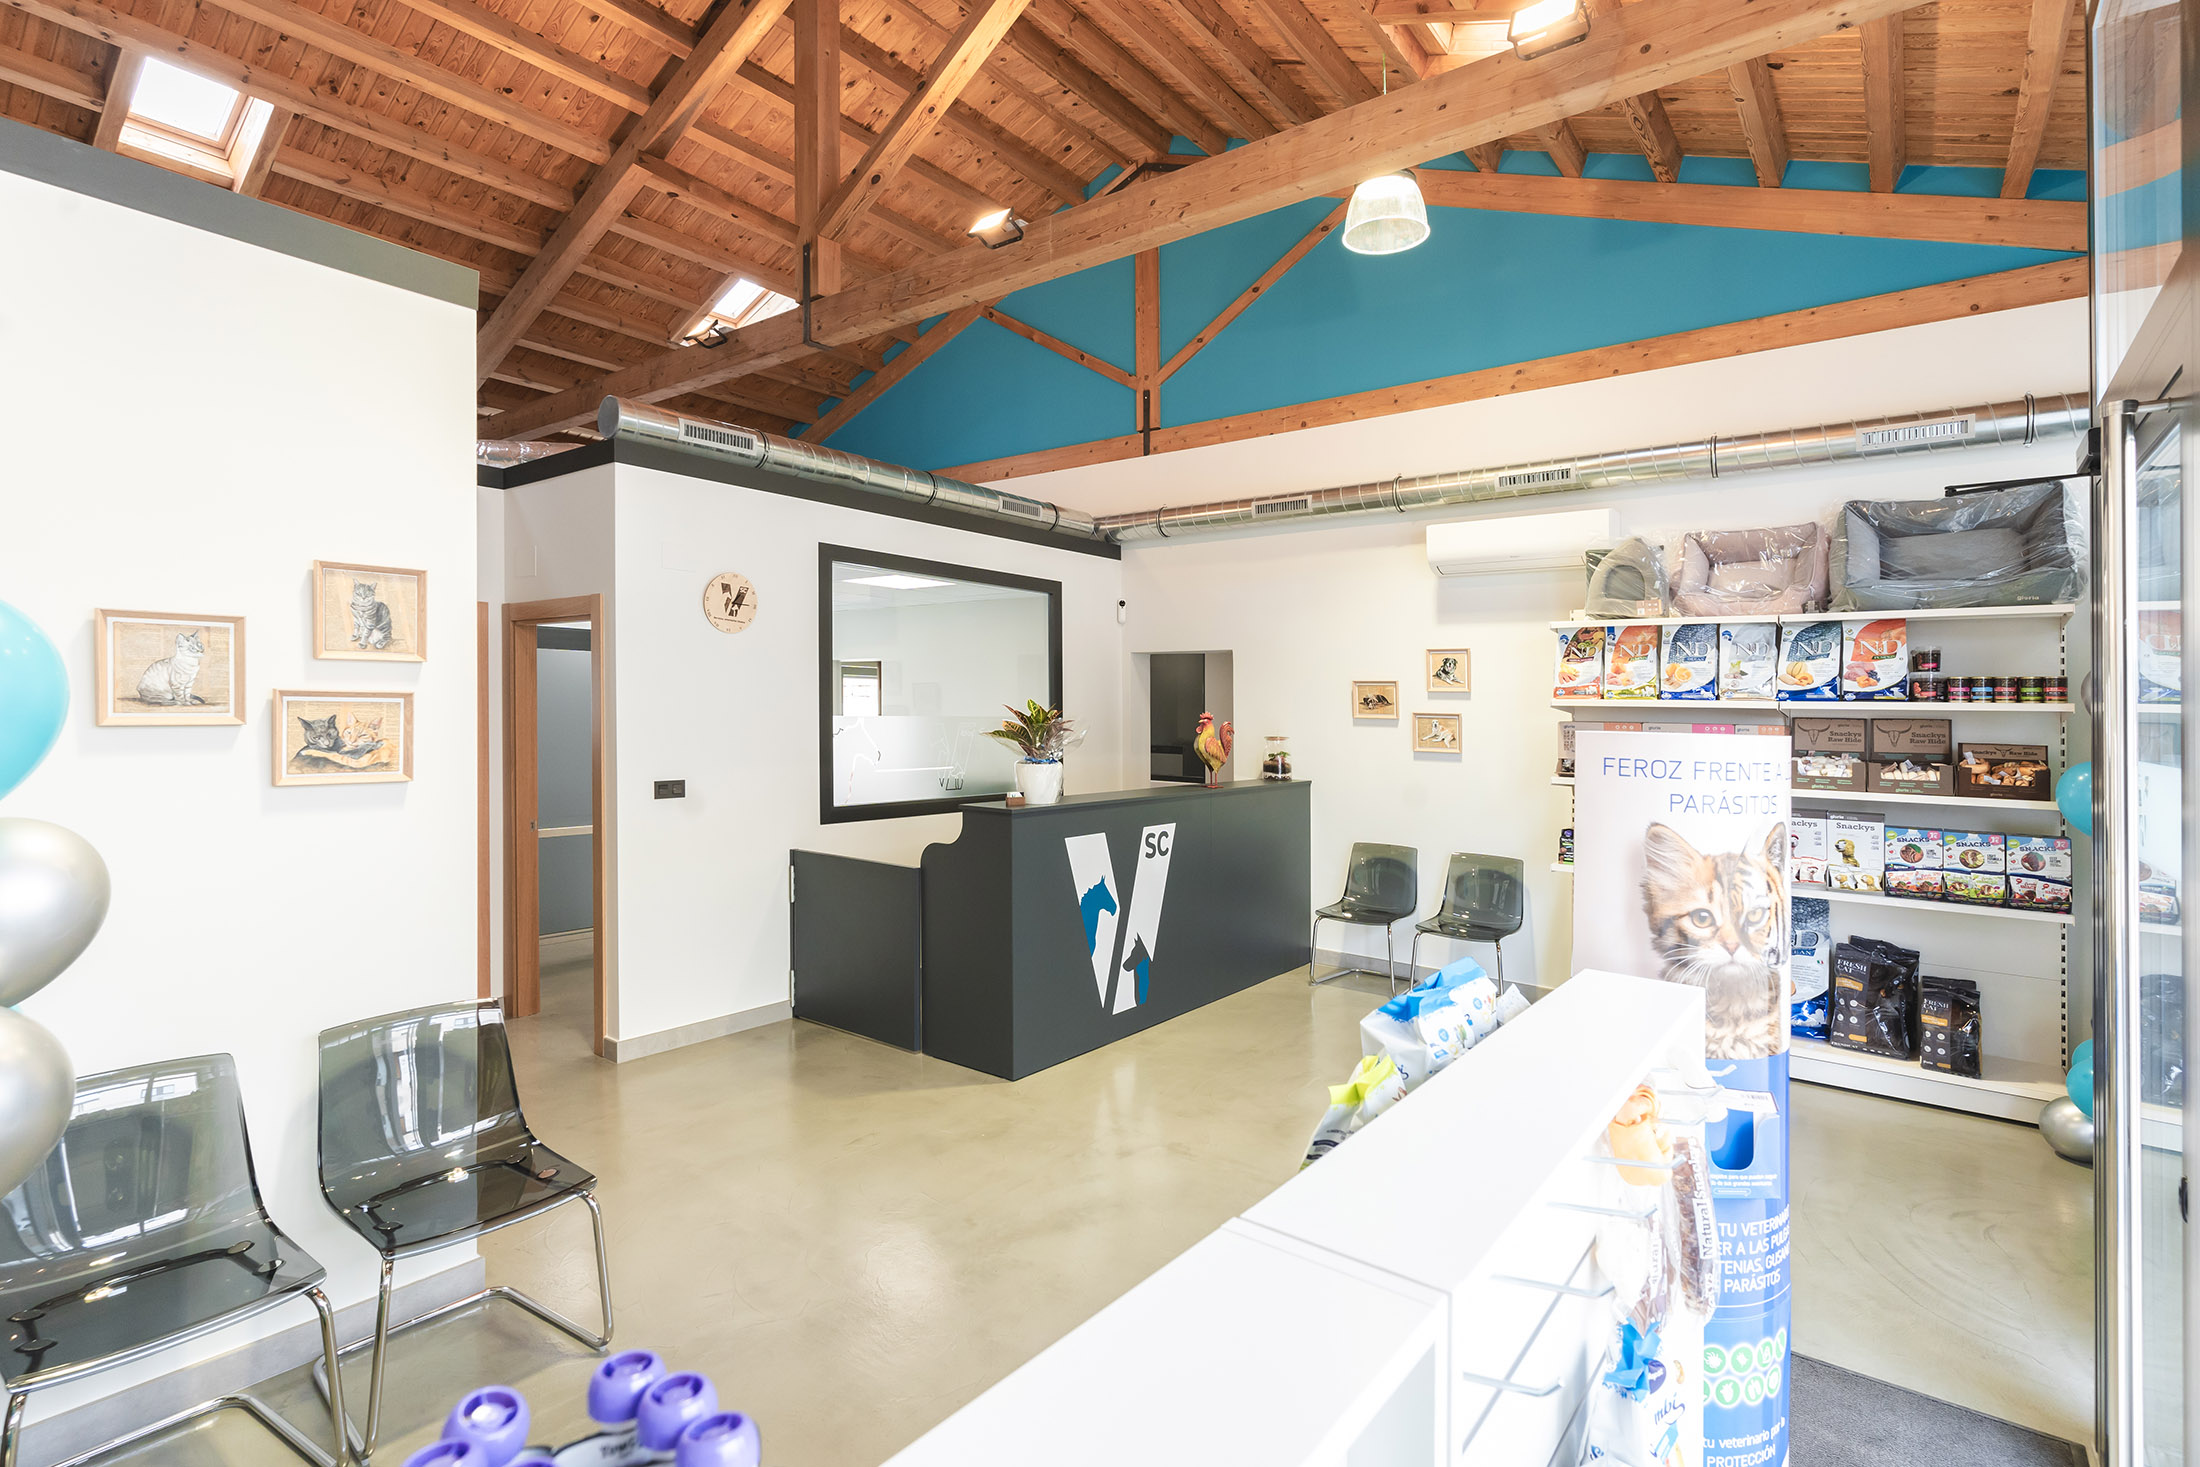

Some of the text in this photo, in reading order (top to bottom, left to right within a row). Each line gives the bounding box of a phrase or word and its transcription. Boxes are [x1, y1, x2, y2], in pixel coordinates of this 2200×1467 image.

[1829, 730, 1862, 738] Snackys
[1911, 731, 1946, 739] Snackys
[1603, 757, 1683, 780] FEROZ
[1693, 761, 1771, 782] FRENTE
[1669, 789, 1777, 815] PARÁSITOS
[1791, 820, 1818, 829] ackys
[1836, 822, 1875, 832] Snackys
[1145, 830, 1169, 859] SC
[1837, 959, 1867, 972] FRESH
[1837, 964, 1852, 973] CAT
[1924, 998, 1949, 1009] FRESH
[1697, 1201, 1713, 1258] Natural
[1717, 1222, 1737, 1237] TU
[1735, 1241, 1746, 1256] A
[1749, 1237, 1770, 1255] LAS
[1724, 1268, 1781, 1294] PARÁSITOS
[1719, 1429, 1770, 1449] veterinario
[1706, 1443, 1776, 1467] PROTECCIÓN
